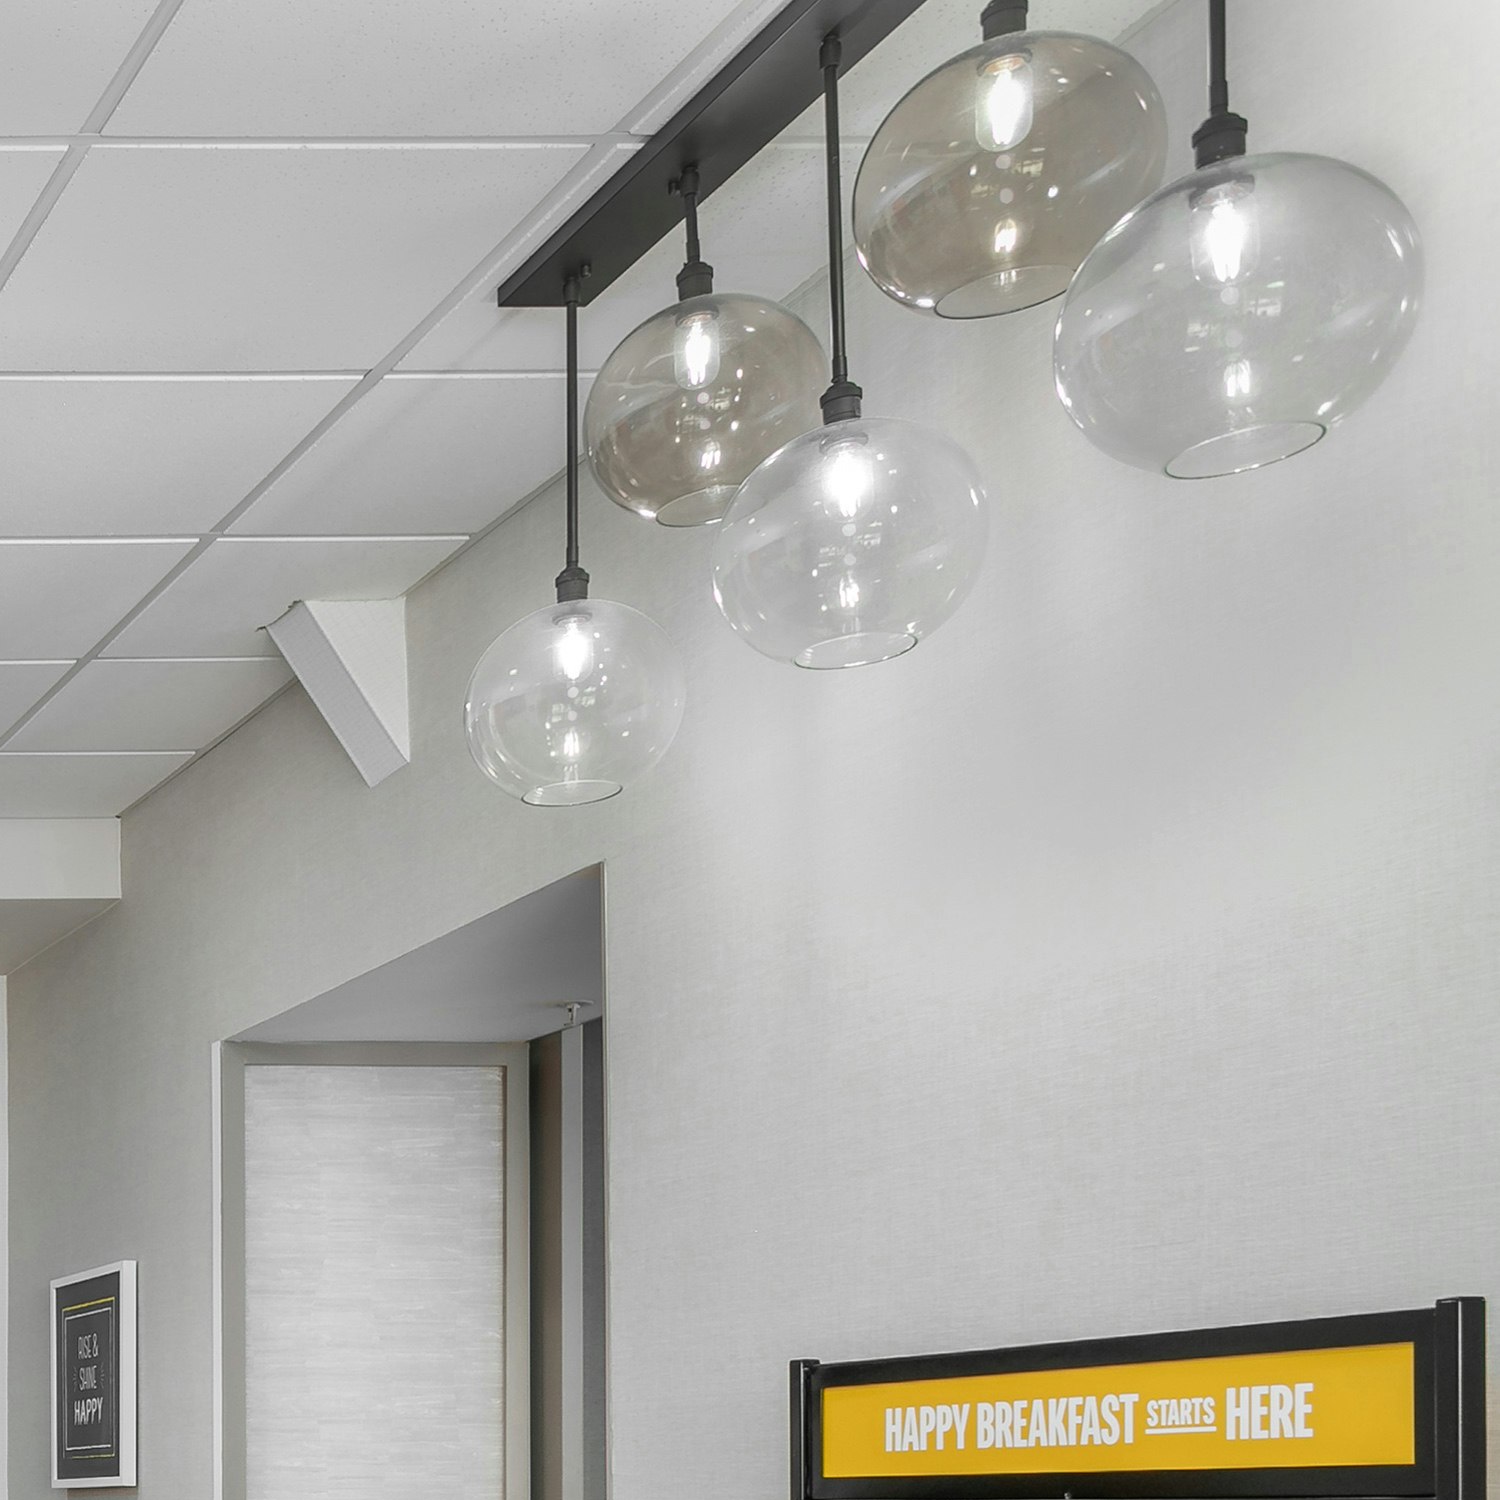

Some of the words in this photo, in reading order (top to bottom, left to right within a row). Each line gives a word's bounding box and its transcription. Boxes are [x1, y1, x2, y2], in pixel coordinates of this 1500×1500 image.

[78, 1334, 91, 1359] RISE
[92, 1333, 98, 1357] &
[79, 1365, 97, 1390] SHINE
[74, 1397, 103, 1425] HAPPY
[885, 1403, 970, 1452] HAPPY
[976, 1393, 1139, 1449] BREAKFAST
[1146, 1396, 1215, 1426] STARTS
[1225, 1383, 1314, 1440] HERE
